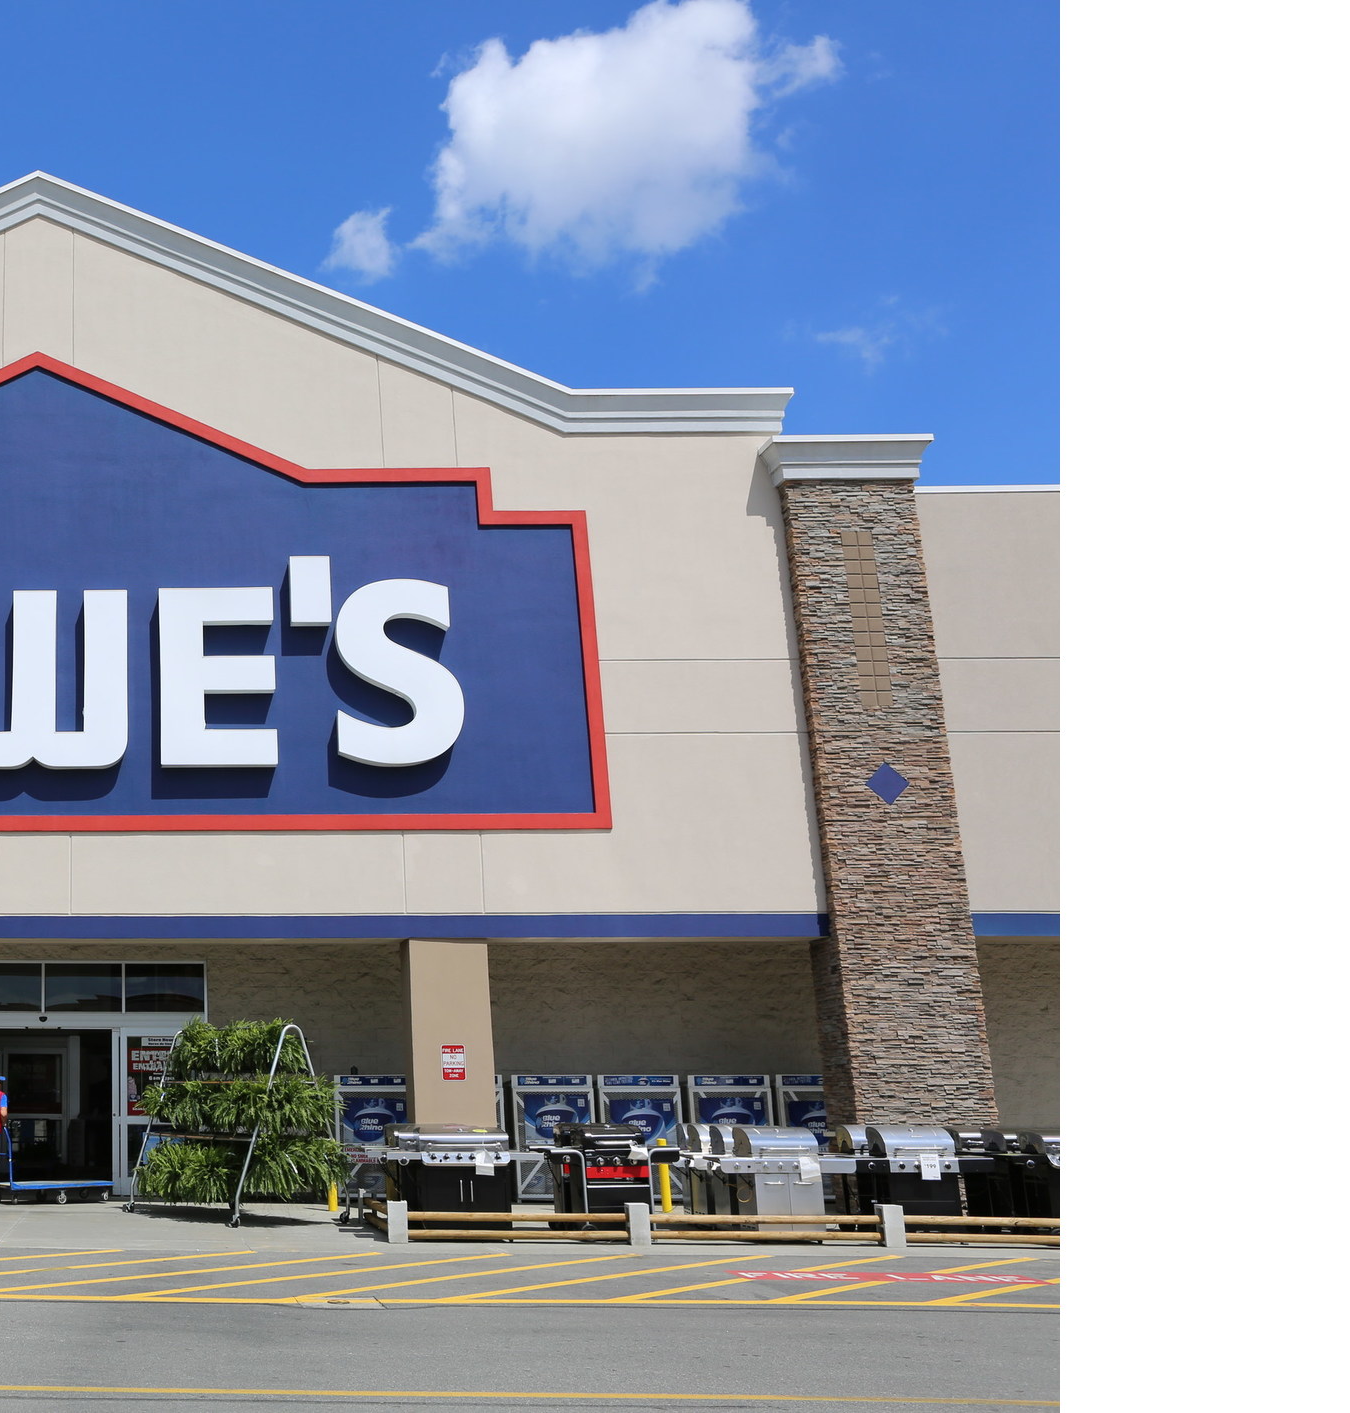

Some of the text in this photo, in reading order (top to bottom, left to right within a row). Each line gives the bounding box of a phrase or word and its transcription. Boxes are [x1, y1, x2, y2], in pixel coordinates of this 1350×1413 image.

[360, 1117, 379, 1125] Blue
[737, 1272, 1037, 1283] FIRE LANE
